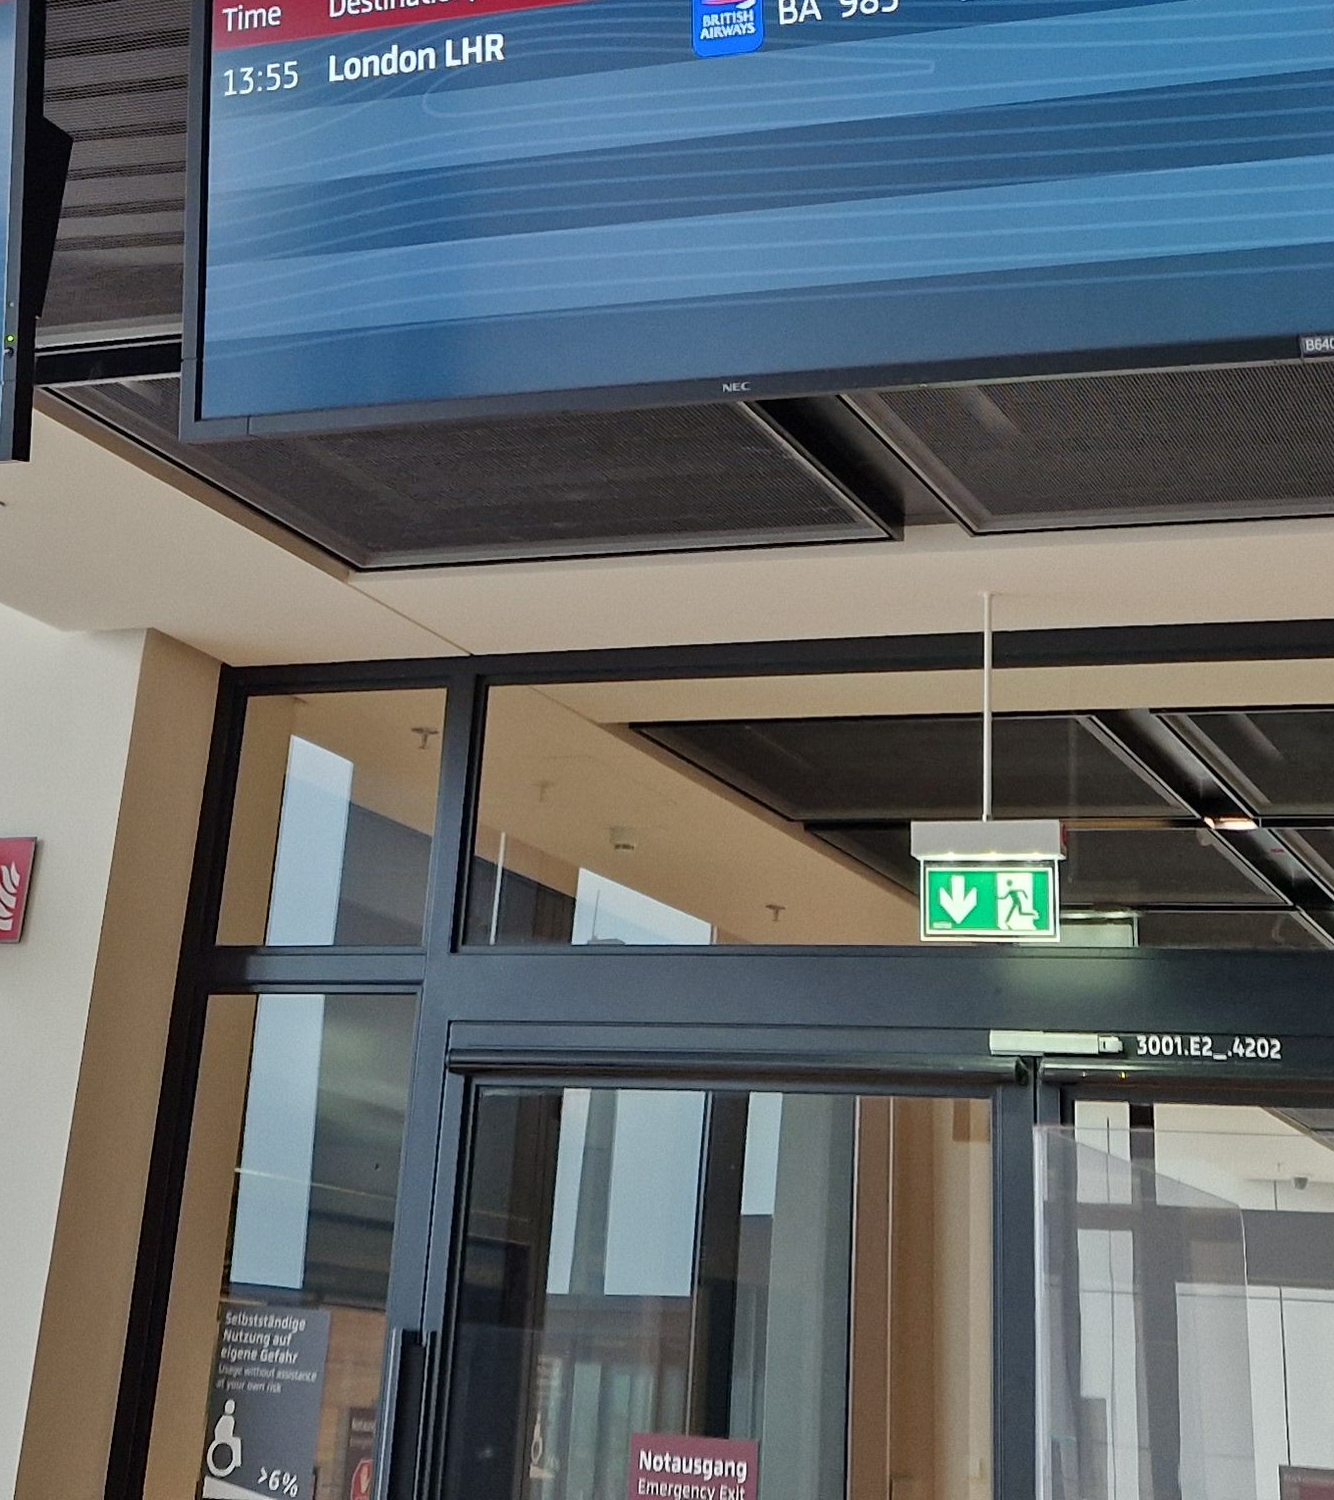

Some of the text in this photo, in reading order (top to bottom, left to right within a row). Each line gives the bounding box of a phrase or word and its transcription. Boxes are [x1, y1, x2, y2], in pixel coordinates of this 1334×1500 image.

[221, 3, 282, 33] Time
[702, 10, 755, 27] BRITISH
[699, 21, 757, 41] AIRWAYS
[222, 60, 300, 97] 13:55
[327, 44, 437, 83] London
[444, 32, 506, 68] LHR
[722, 381, 752, 393] NEC
[1135, 1034, 1283, 1061] 3001.E2_.4202
[225, 1311, 307, 1334] Selbstständige
[222, 1329, 293, 1348] Nutzung auf
[220, 1345, 299, 1366] eigene Gefahr
[638, 1448, 748, 1484] Notausgang
[637, 1476, 745, 1500] Emergency Exit
